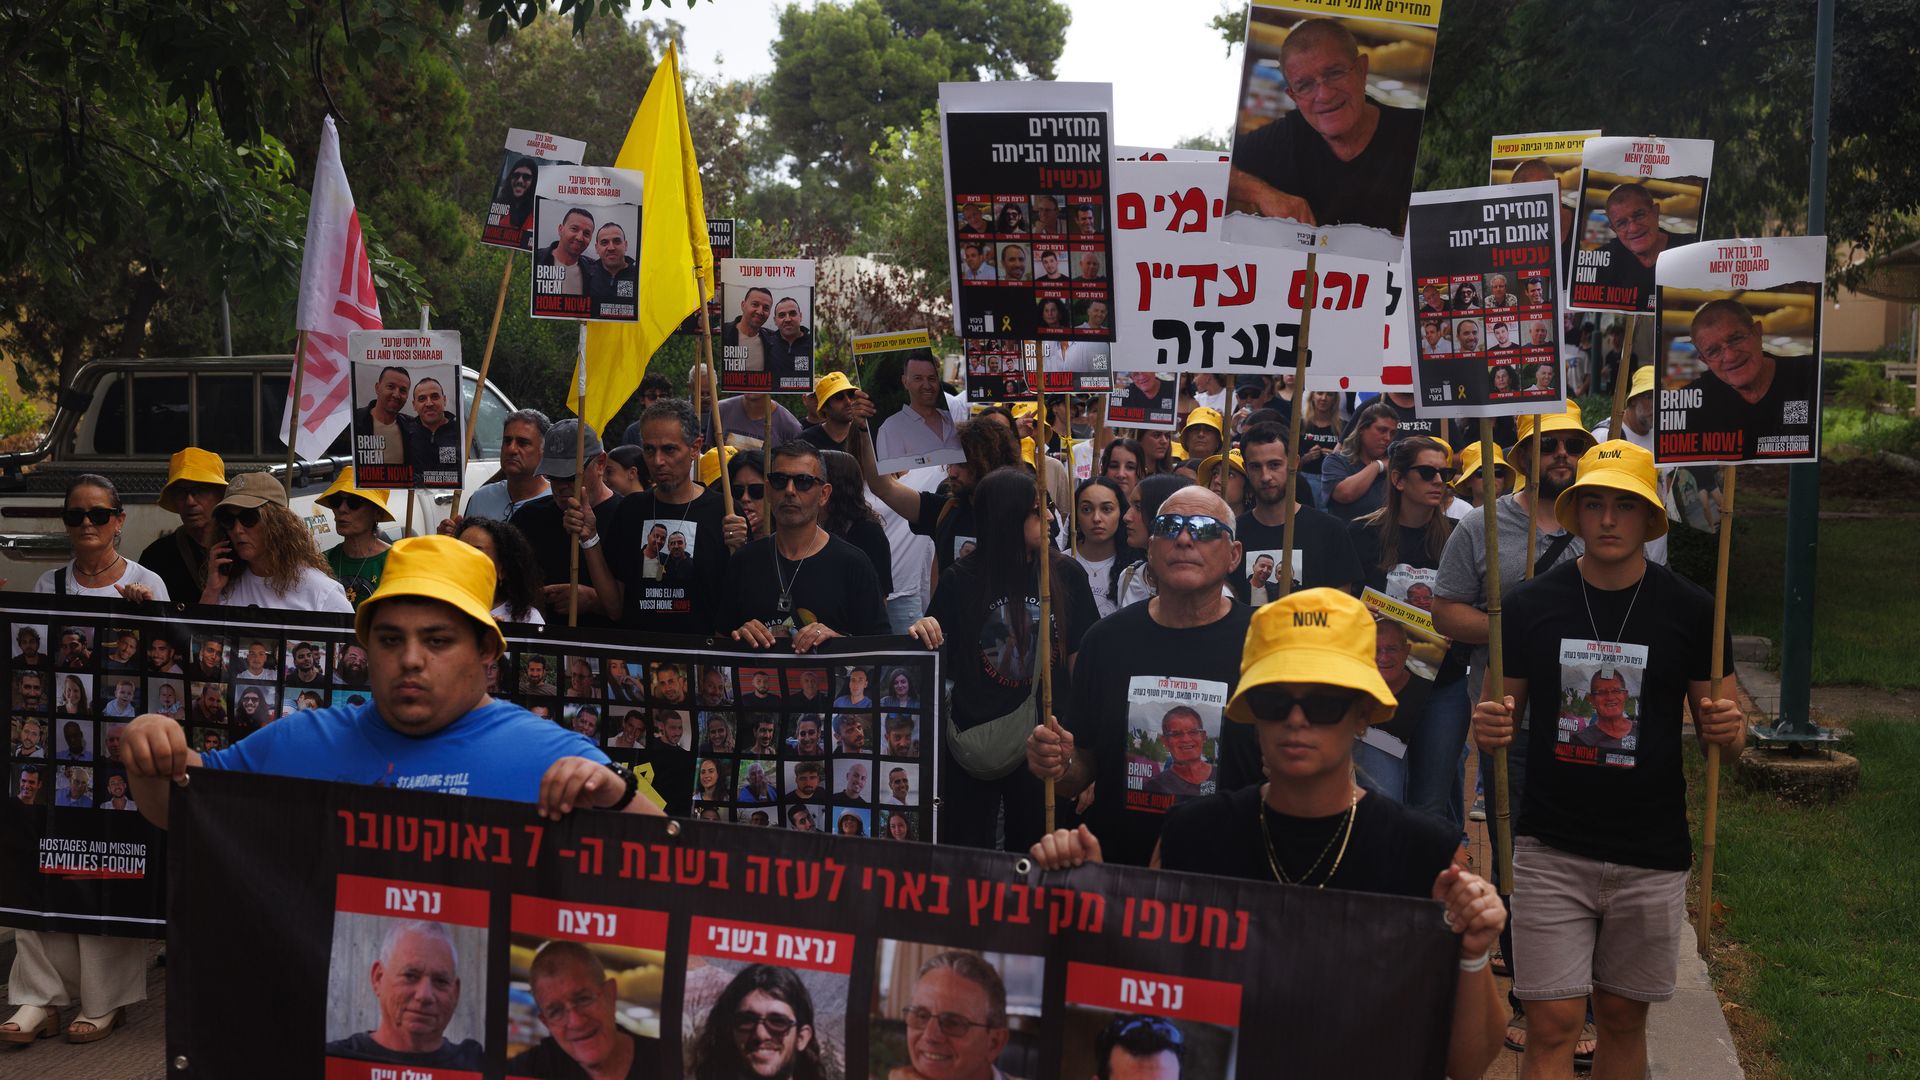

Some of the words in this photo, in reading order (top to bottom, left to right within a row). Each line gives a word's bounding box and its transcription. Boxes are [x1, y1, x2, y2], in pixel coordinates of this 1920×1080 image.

[1386, 1, 1431, 16] מחזירים
[1029, 118, 1100, 136] מחזירים
[1498, 144, 1520, 153] עכשיו!
[1521, 143, 1542, 151] הביתה
[1544, 142, 1553, 150] מני
[1555, 141, 1565, 149] את
[1632, 143, 1654, 153] גודארד
[1656, 144, 1665, 154] מני
[992, 144, 1048, 162] הביתה
[1054, 144, 1100, 163] אותם
[1624, 153, 1643, 163] MENY
[1644, 155, 1670, 165] GODARD
[1640, 164, 1653, 175] (73)
[1040, 166, 1102, 188] עכשיו!
[558, 186, 567, 194] ELI
[568, 186, 578, 194] AND
[580, 187, 596, 195] YOSSI
[596, 188, 620, 197] SHARABI
[490, 202, 510, 215] BRING
[1482, 200, 1548, 222] מחזירים
[487, 214, 500, 226] HIM
[1450, 227, 1501, 248] הביתה
[1505, 223, 1549, 243] אותם
[1492, 246, 1549, 267] עכשיו!
[1578, 250, 1611, 266] BRING
[1718, 247, 1747, 259] גודארד
[1750, 246, 1762, 258] מני
[536, 265, 566, 279] BRING
[740, 266, 762, 277] שרעבי
[766, 266, 781, 277] ויוסי
[783, 266, 796, 277] אלי
[1710, 261, 1734, 273] MENY
[1735, 259, 1769, 271] GODARD
[1576, 266, 1597, 283] HIM
[1731, 273, 1748, 287] (73)
[536, 280, 562, 294] THEM
[1136, 262, 1257, 311] עדיין
[1288, 270, 1370, 311] והם
[1574, 284, 1604, 301] HOME
[1606, 286, 1638, 304] NOW!
[536, 296, 562, 310] HOME
[564, 296, 591, 312] NOW!
[420, 337, 430, 347] אלי
[1153, 320, 1313, 368] בעזה
[366, 350, 376, 360] ELI
[377, 350, 390, 360] AND
[392, 350, 412, 360] YOSSI
[412, 350, 442, 360] SHARABI
[724, 346, 748, 358] BRING
[724, 359, 746, 371] THEM
[724, 372, 745, 384] HOME
[748, 371, 772, 386] NOW!
[1660, 388, 1703, 410] BRING
[1660, 411, 1686, 431] HIM
[358, 435, 385, 450] BRING
[1659, 432, 1699, 454] HOME
[1702, 429, 1743, 453] NOW!
[1757, 443, 1785, 452] FAMILIES
[1786, 442, 1809, 452] FORUM
[358, 450, 384, 464] THEM
[1598, 450, 1621, 459] NOW.
[360, 466, 384, 480] HOME
[387, 464, 413, 480] NOW!
[645, 588, 663, 598] BRING
[672, 589, 685, 598] AND
[639, 600, 655, 610] YOSSI
[656, 600, 673, 610] HOME
[1367, 595, 1386, 608] עכשיו!
[1386, 604, 1405, 616] הביתה
[1406, 612, 1415, 620] מני
[1293, 611, 1330, 628] NOW.
[1416, 616, 1425, 625] את
[1170, 680, 1188, 689] גודארד
[1161, 690, 1174, 698] עדיין
[1174, 691, 1192, 700] חמאס,
[1201, 693, 1208, 701] על
[1208, 694, 1222, 703] נרצח
[1558, 717, 1578, 731] BRING
[1558, 729, 1570, 743] HIM
[1128, 762, 1152, 777] BRING
[396, 774, 442, 788] STANDING
[444, 773, 469, 786] STILL
[1128, 777, 1142, 790] HIM
[1127, 791, 1149, 805] HOME
[337, 809, 512, 865] באוקטובר
[40, 838, 87, 852] HOSTAGES
[89, 841, 107, 854] AND
[109, 842, 146, 856] MISSING
[524, 825, 544, 868] 7
[40, 852, 98, 870] FAMILIES
[102, 855, 146, 874] FORUM
[558, 837, 604, 876] ה-
[618, 840, 730, 890] בשבת
[745, 853, 845, 902] לעזה
[861, 868, 951, 915] בארי
[384, 886, 442, 915] נרצח
[967, 878, 1106, 936] מקיבוץ
[557, 908, 618, 938] נרצח
[1121, 895, 1250, 950] נחטפו
[706, 926, 768, 957] בשבי
[776, 932, 837, 965] נרצח
[1120, 978, 1184, 1011] נרצח
